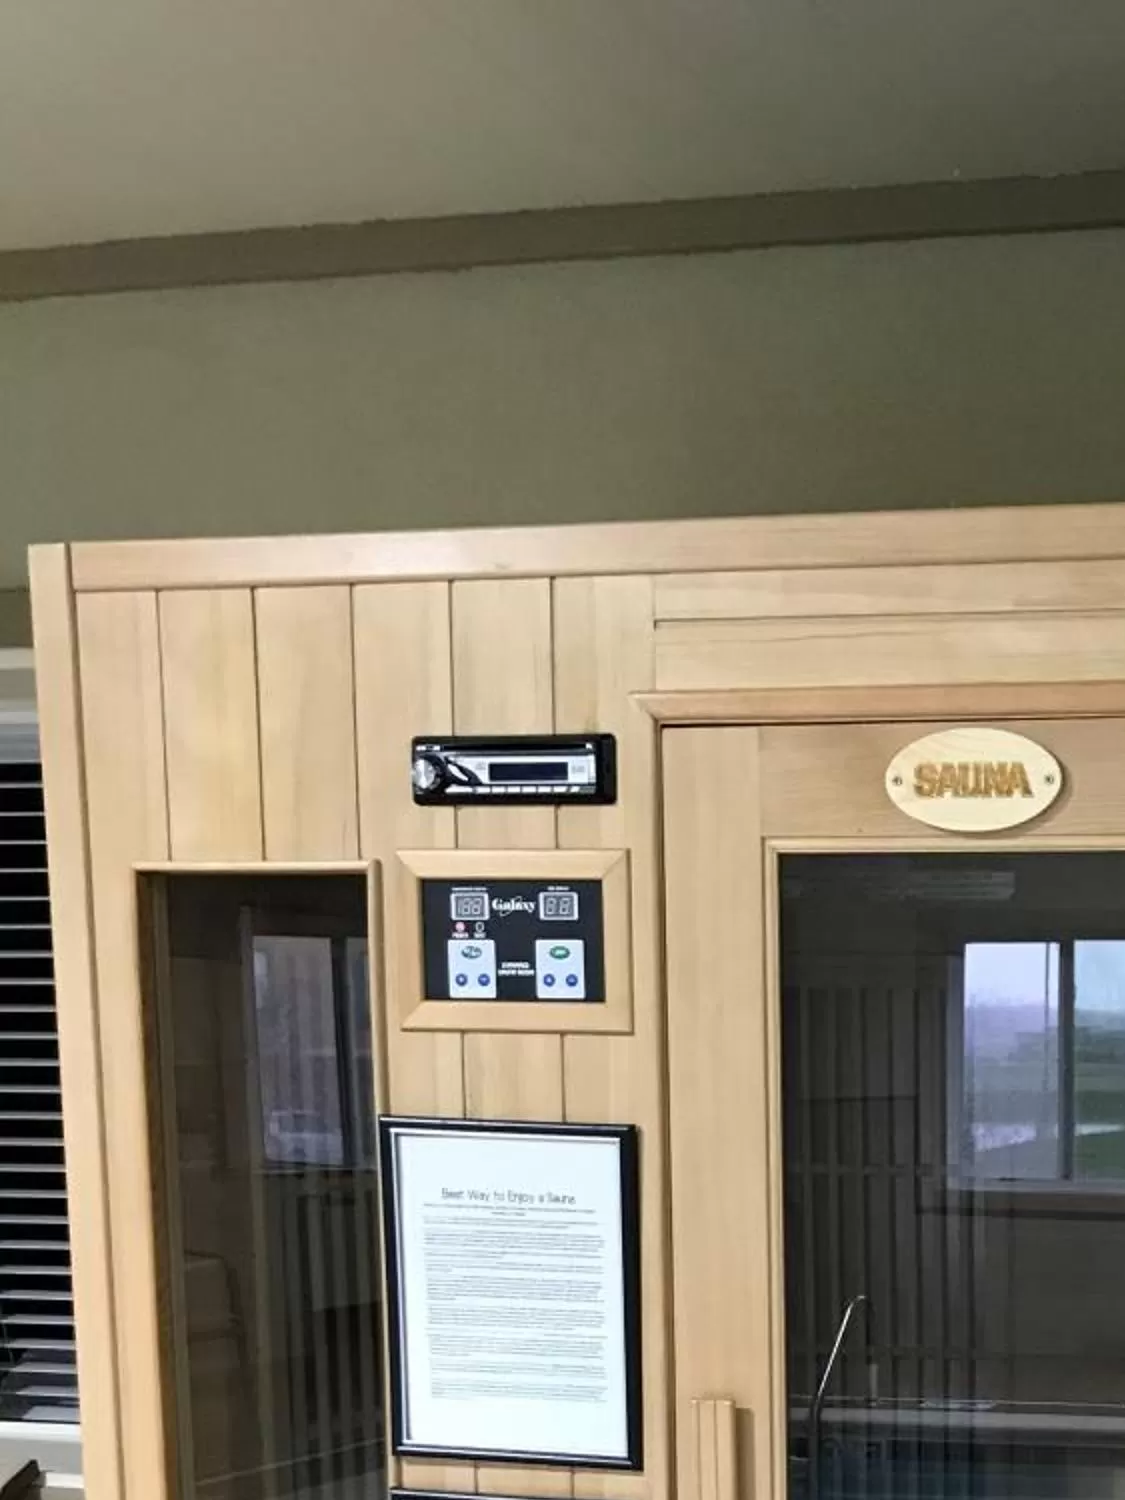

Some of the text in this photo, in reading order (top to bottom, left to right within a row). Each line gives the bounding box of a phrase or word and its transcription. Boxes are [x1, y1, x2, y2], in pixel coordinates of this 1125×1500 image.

[914, 761, 1034, 798] SAUNA
[491, 896, 536, 917] Galaxy
[467, 1189, 489, 1202] Way
[507, 1190, 535, 1205] Enjoy
